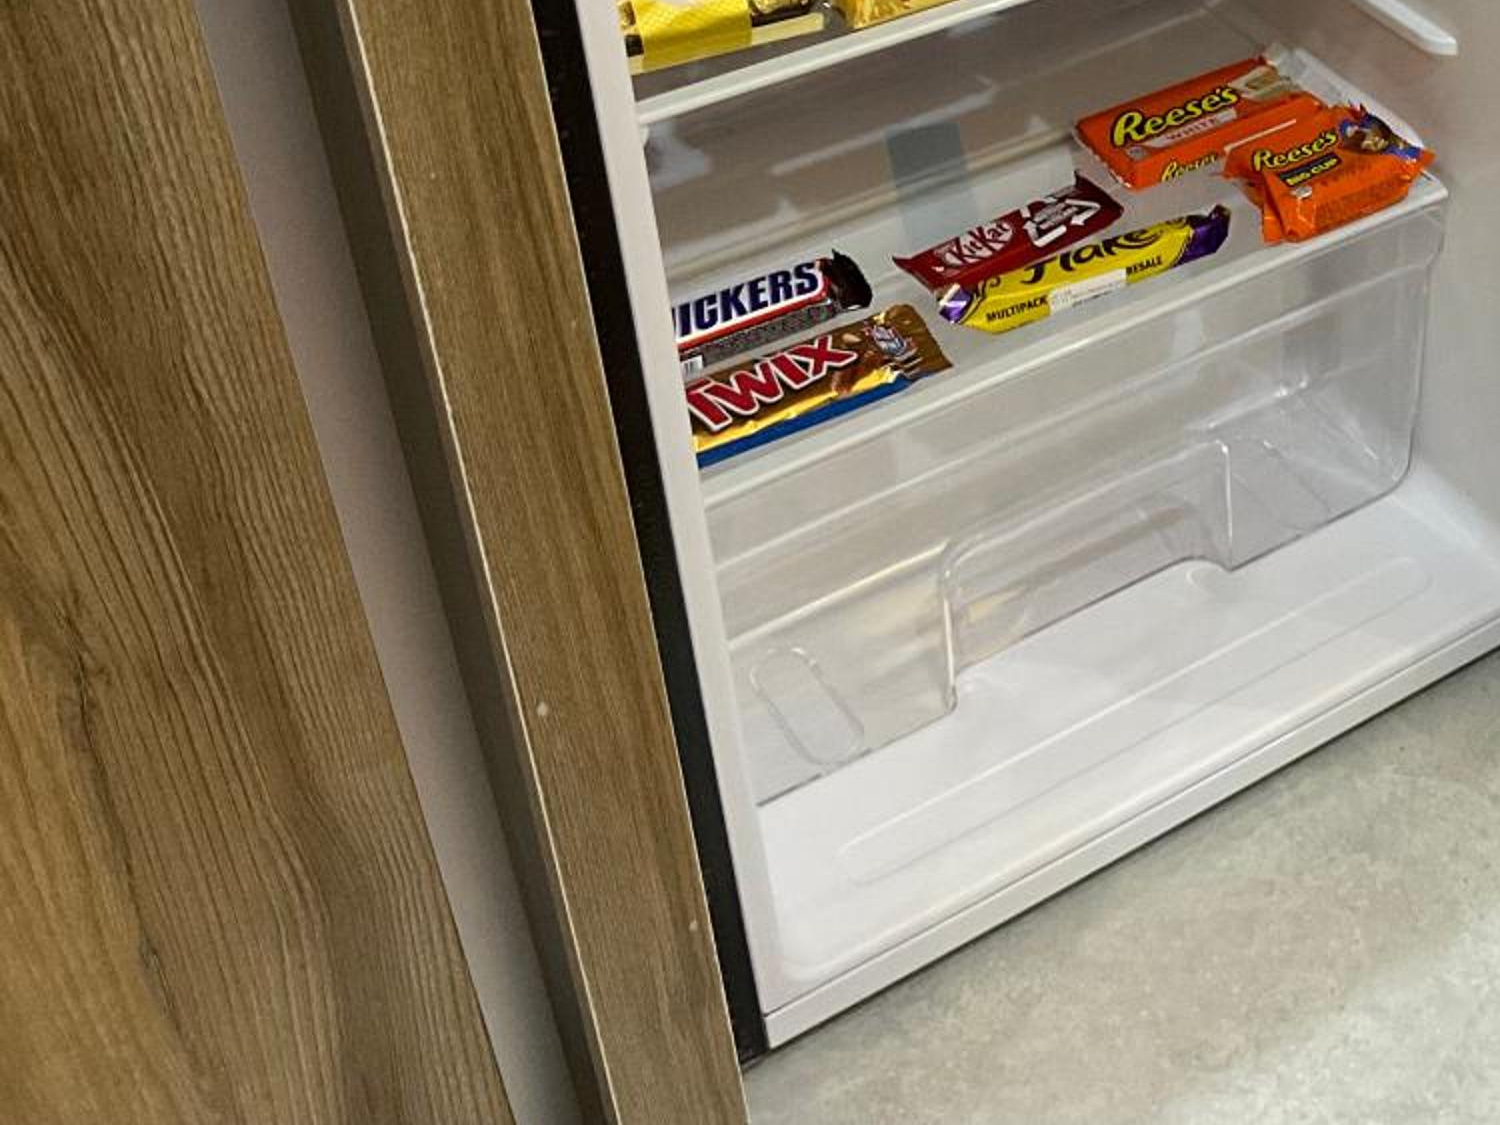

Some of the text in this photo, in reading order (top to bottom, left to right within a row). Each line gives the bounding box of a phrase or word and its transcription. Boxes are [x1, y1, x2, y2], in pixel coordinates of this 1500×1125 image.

[1113, 87, 1239, 147] Reese's
[1254, 131, 1339, 171] Reese's
[1126, 256, 1163, 276] RESALE
[673, 261, 820, 338] ICKERS
[986, 295, 1049, 322] MULTIPACK
[685, 335, 857, 431] TWIX
